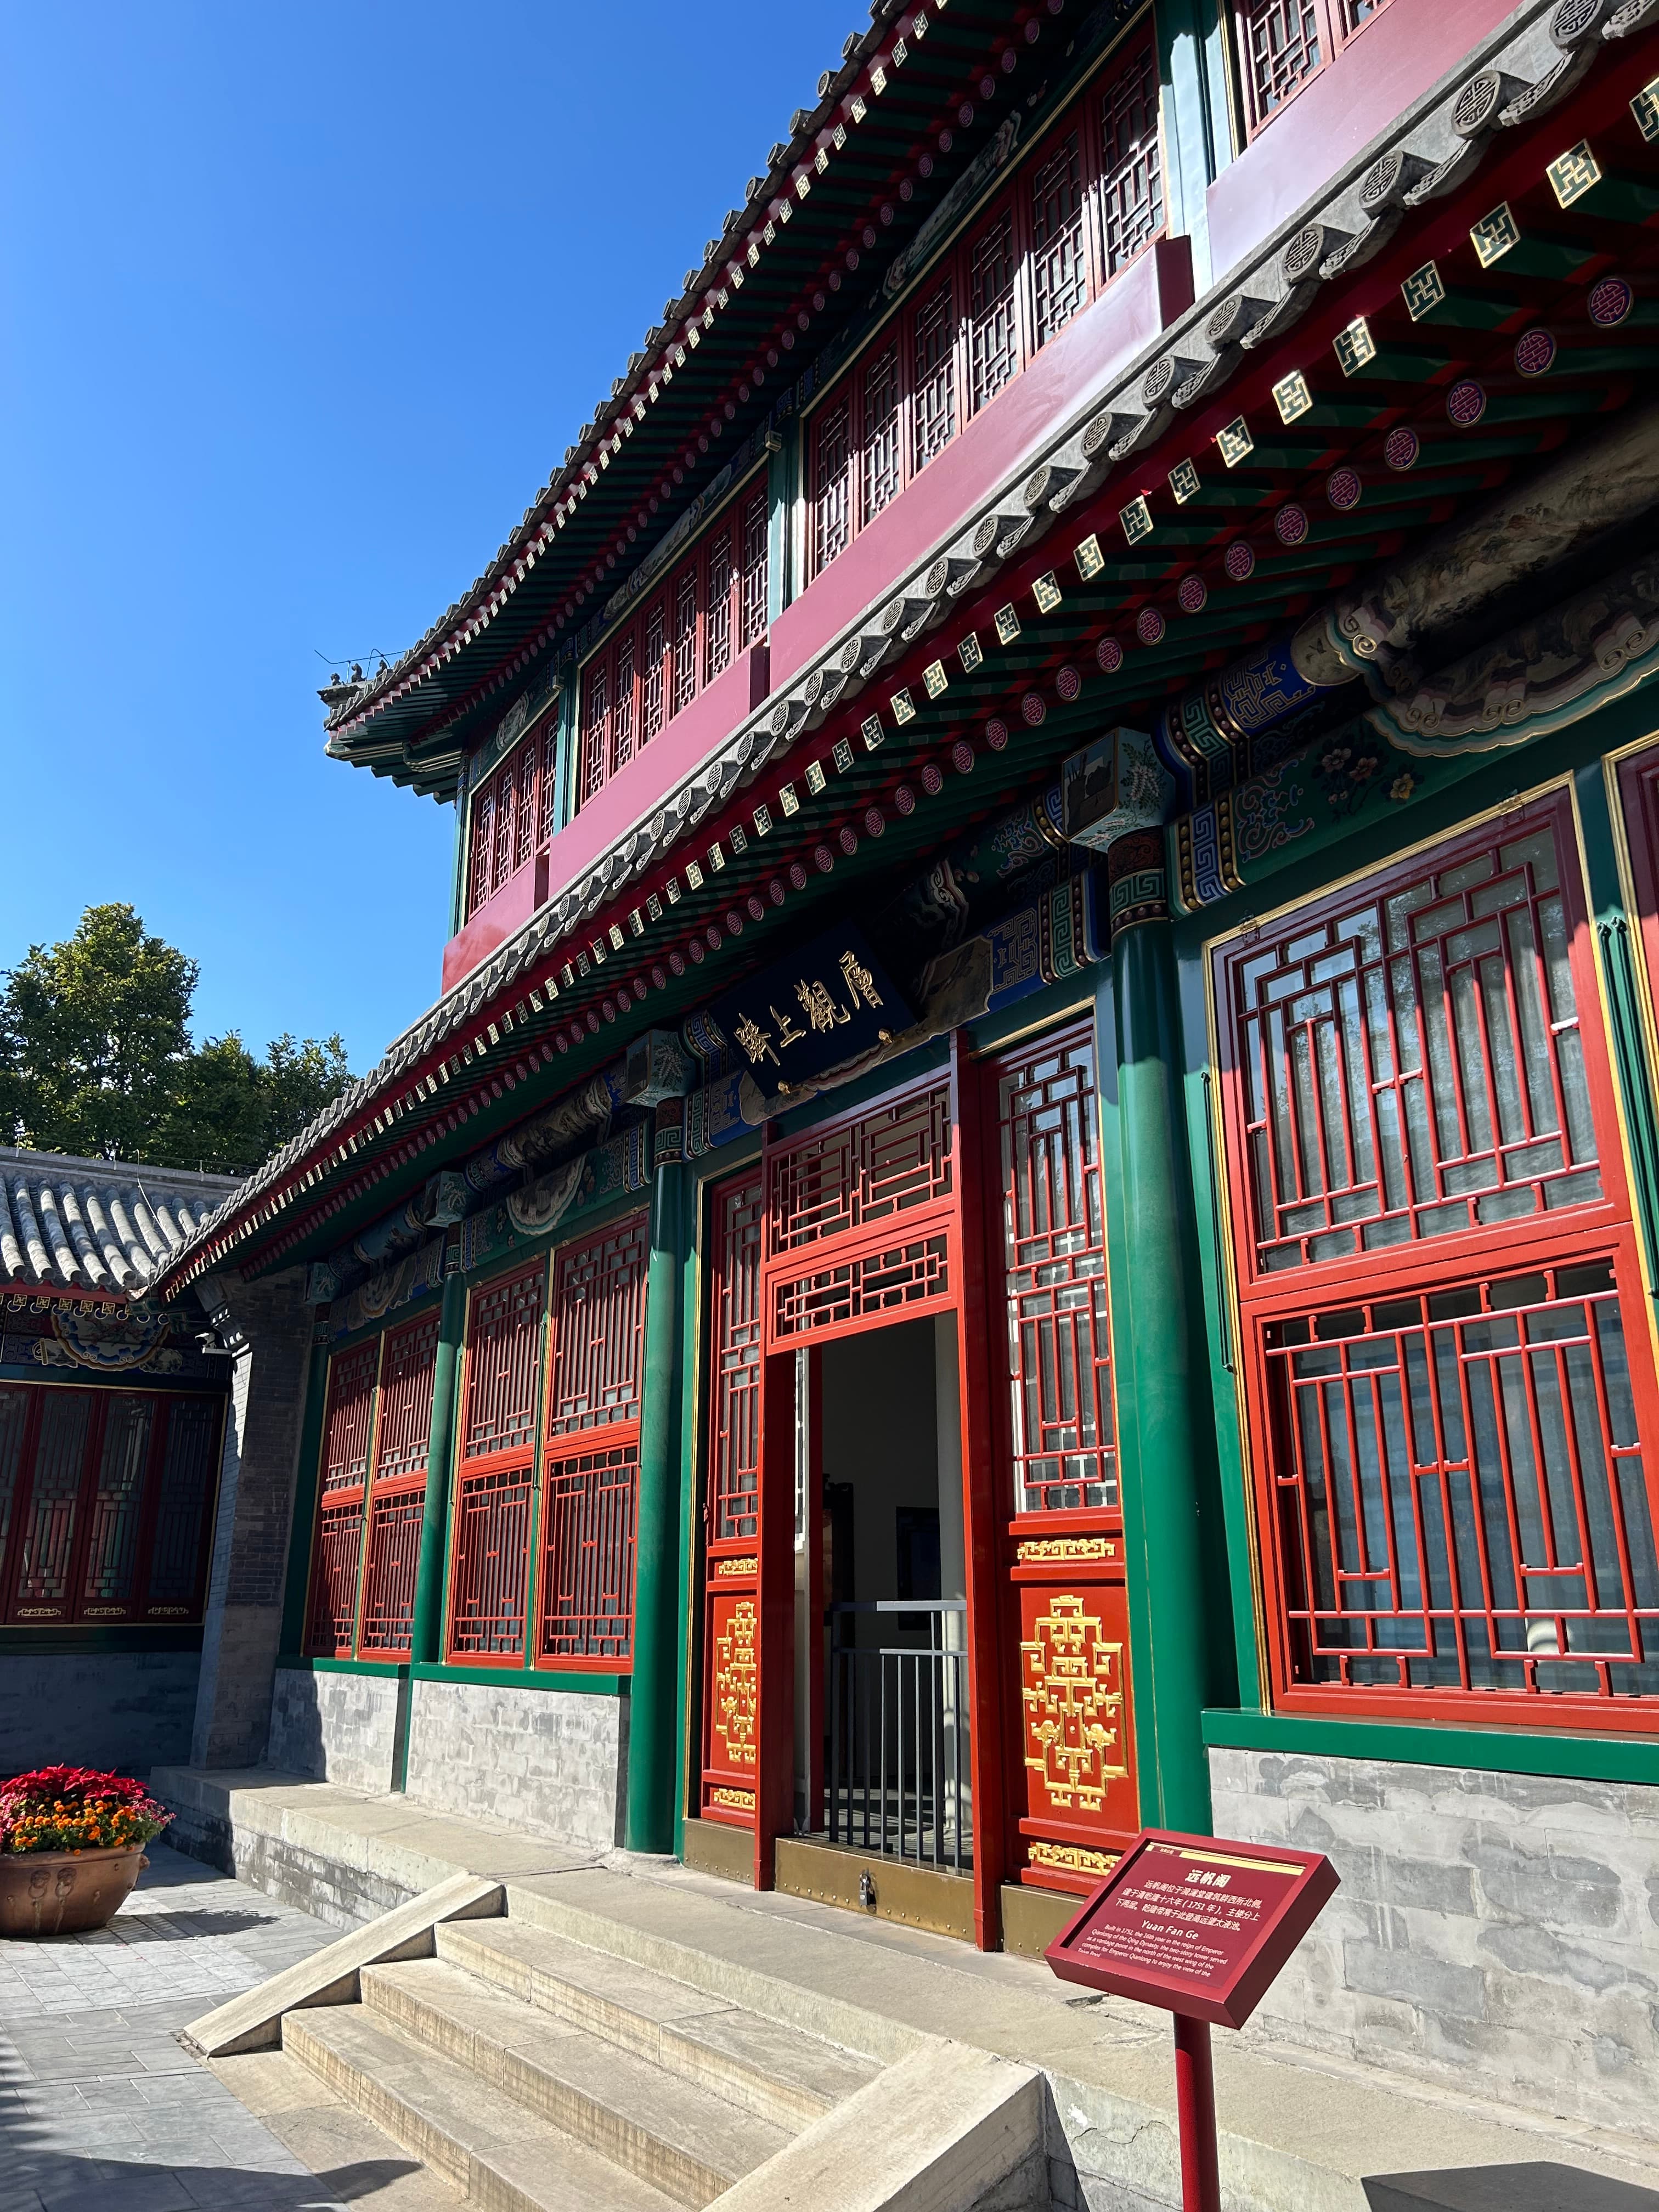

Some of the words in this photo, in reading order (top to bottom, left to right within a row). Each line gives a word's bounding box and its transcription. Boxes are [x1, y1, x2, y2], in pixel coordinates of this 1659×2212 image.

[1184, 1869, 1232, 1888] 远帆阁
[1142, 1920, 1164, 1932] Yuan
[1165, 1925, 1183, 1937] Fan
[1185, 1930, 1199, 1940] Ge
[1127, 1937, 1139, 1945] Qing
[1169, 1947, 1194, 1958] two-story
[1201, 1945, 1224, 1955] Emperor
[1108, 1948, 1129, 1957] Emperor
[1158, 1961, 1173, 1969] enjoy
[1184, 1959, 1198, 1967] wing
